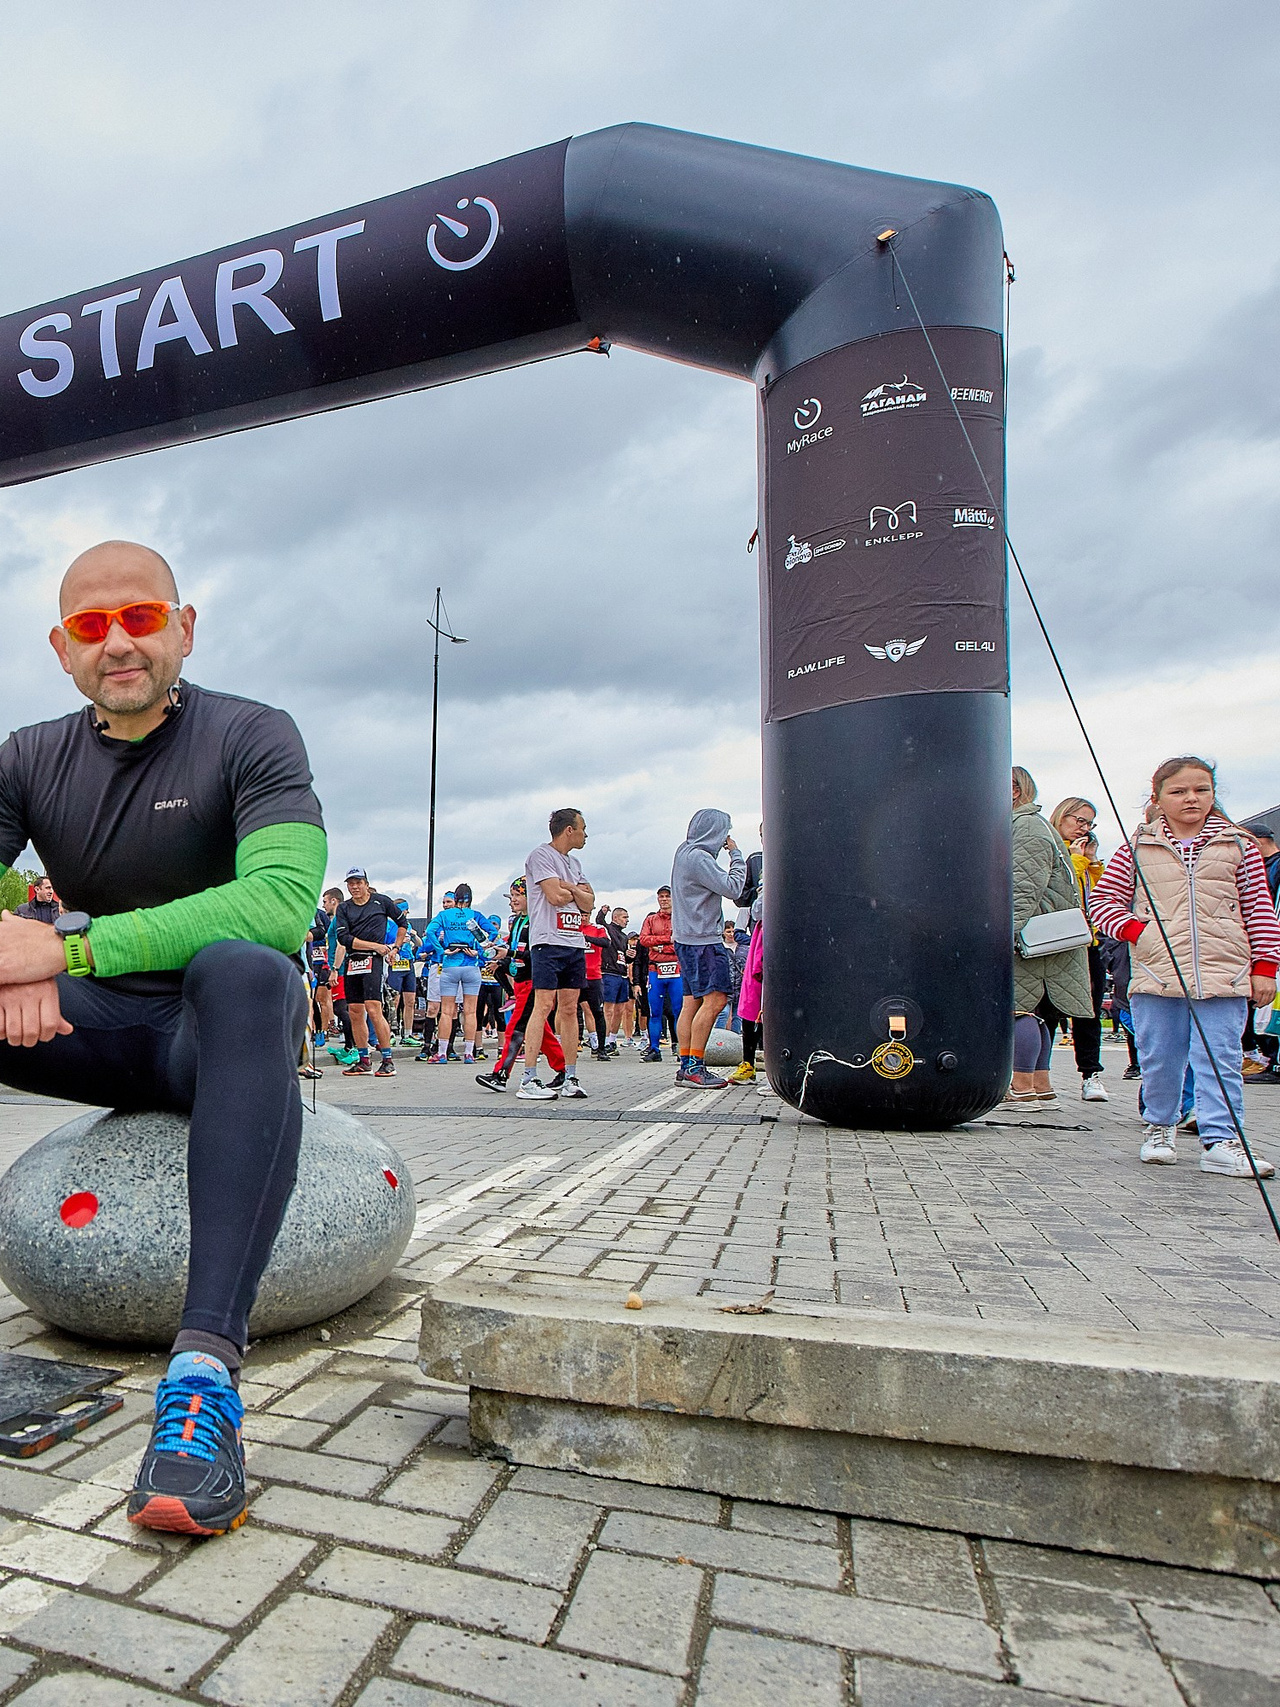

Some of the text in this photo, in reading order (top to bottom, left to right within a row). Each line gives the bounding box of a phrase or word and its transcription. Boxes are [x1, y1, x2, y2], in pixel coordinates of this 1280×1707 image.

[17, 219, 366, 398] START
[786, 425, 834, 454] MyRace
[954, 508, 988, 523] Mätti
[865, 531, 924, 547] ENKLEPP
[955, 641, 996, 652] GEL4U
[350, 958, 370, 968] 1049
